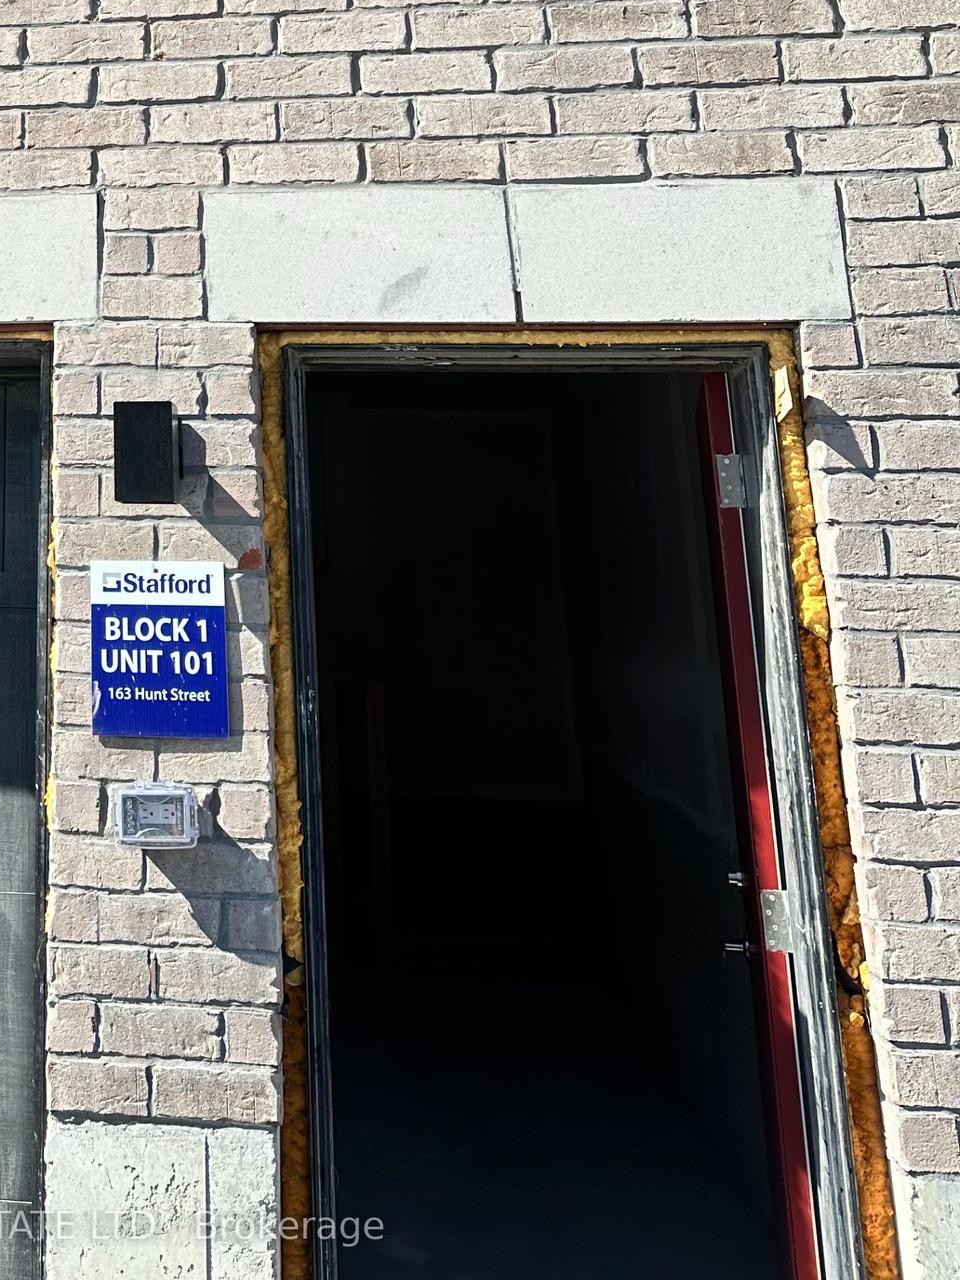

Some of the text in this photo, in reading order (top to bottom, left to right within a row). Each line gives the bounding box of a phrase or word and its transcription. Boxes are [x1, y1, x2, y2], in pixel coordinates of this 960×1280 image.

[123, 572, 211, 594] Stafford
[104, 616, 208, 642] BLOCK 1
[100, 648, 213, 675] UNIT 101
[108, 686, 211, 702] 163 Hunt Street
